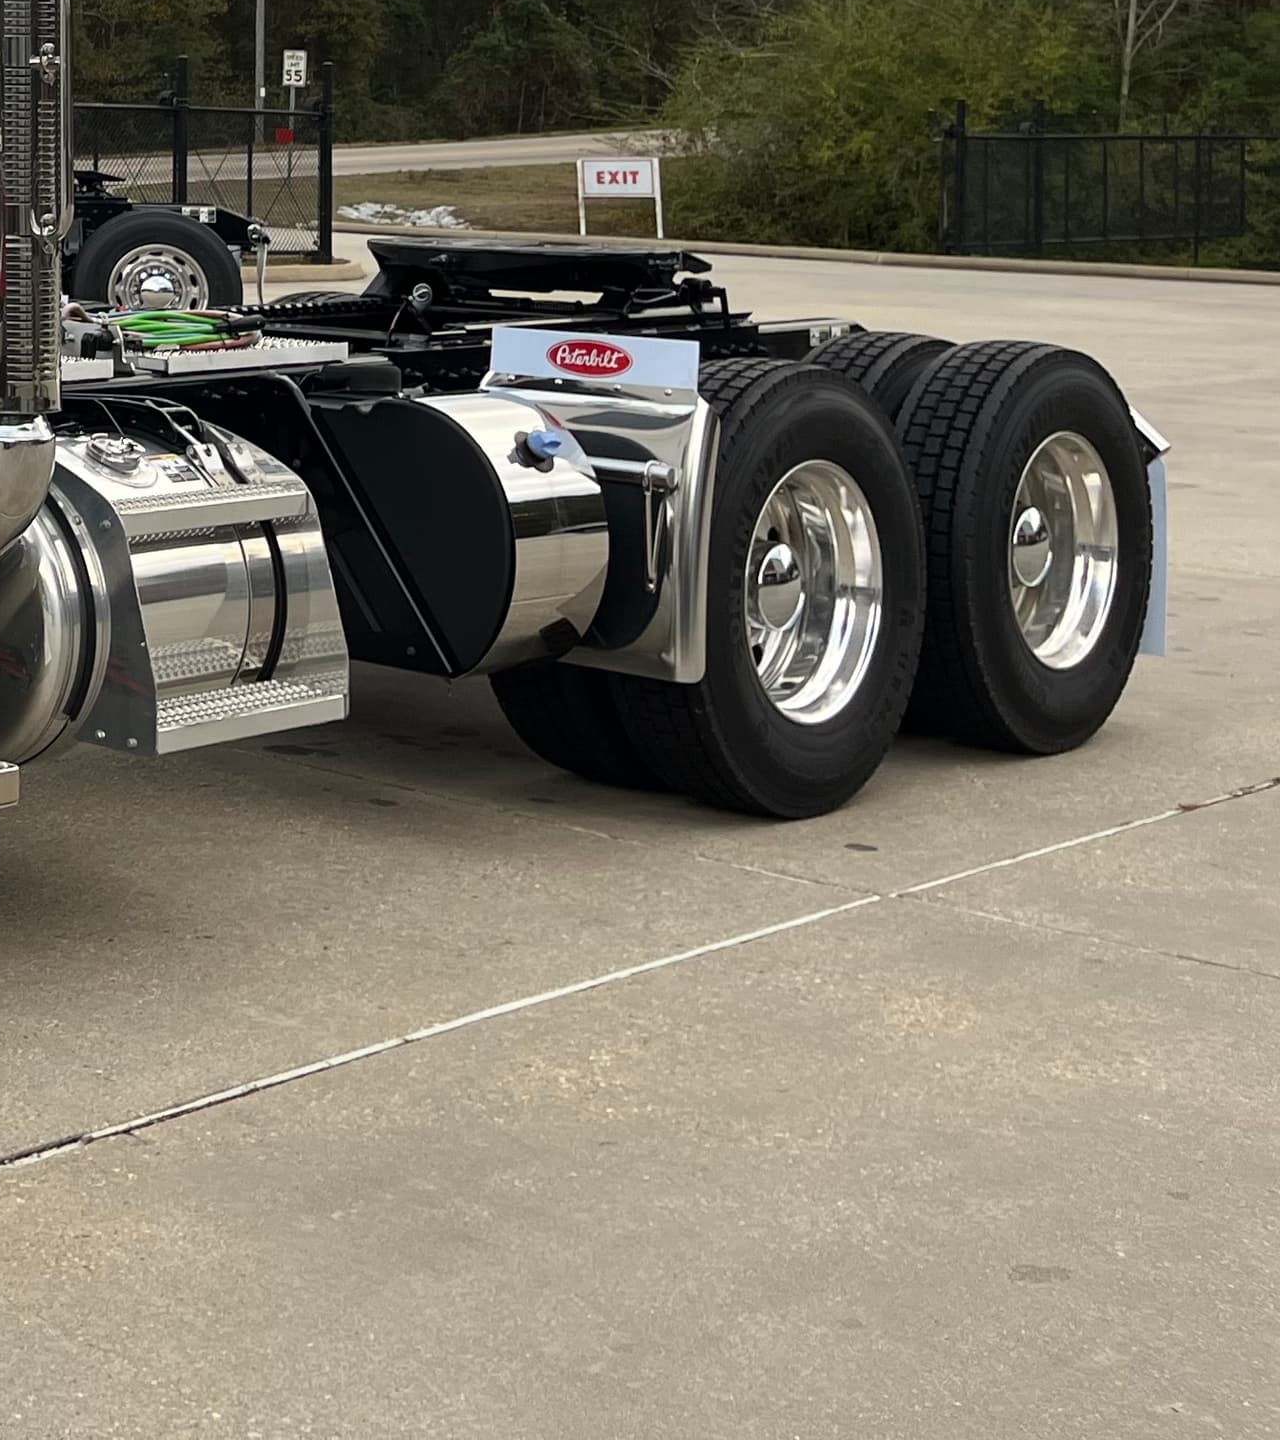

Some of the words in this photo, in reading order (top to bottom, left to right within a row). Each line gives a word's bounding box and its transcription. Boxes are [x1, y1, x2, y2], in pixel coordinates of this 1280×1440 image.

[285, 69, 302, 82] 55
[596, 171, 639, 185] EXIT
[556, 344, 625, 369] Peterbilt
